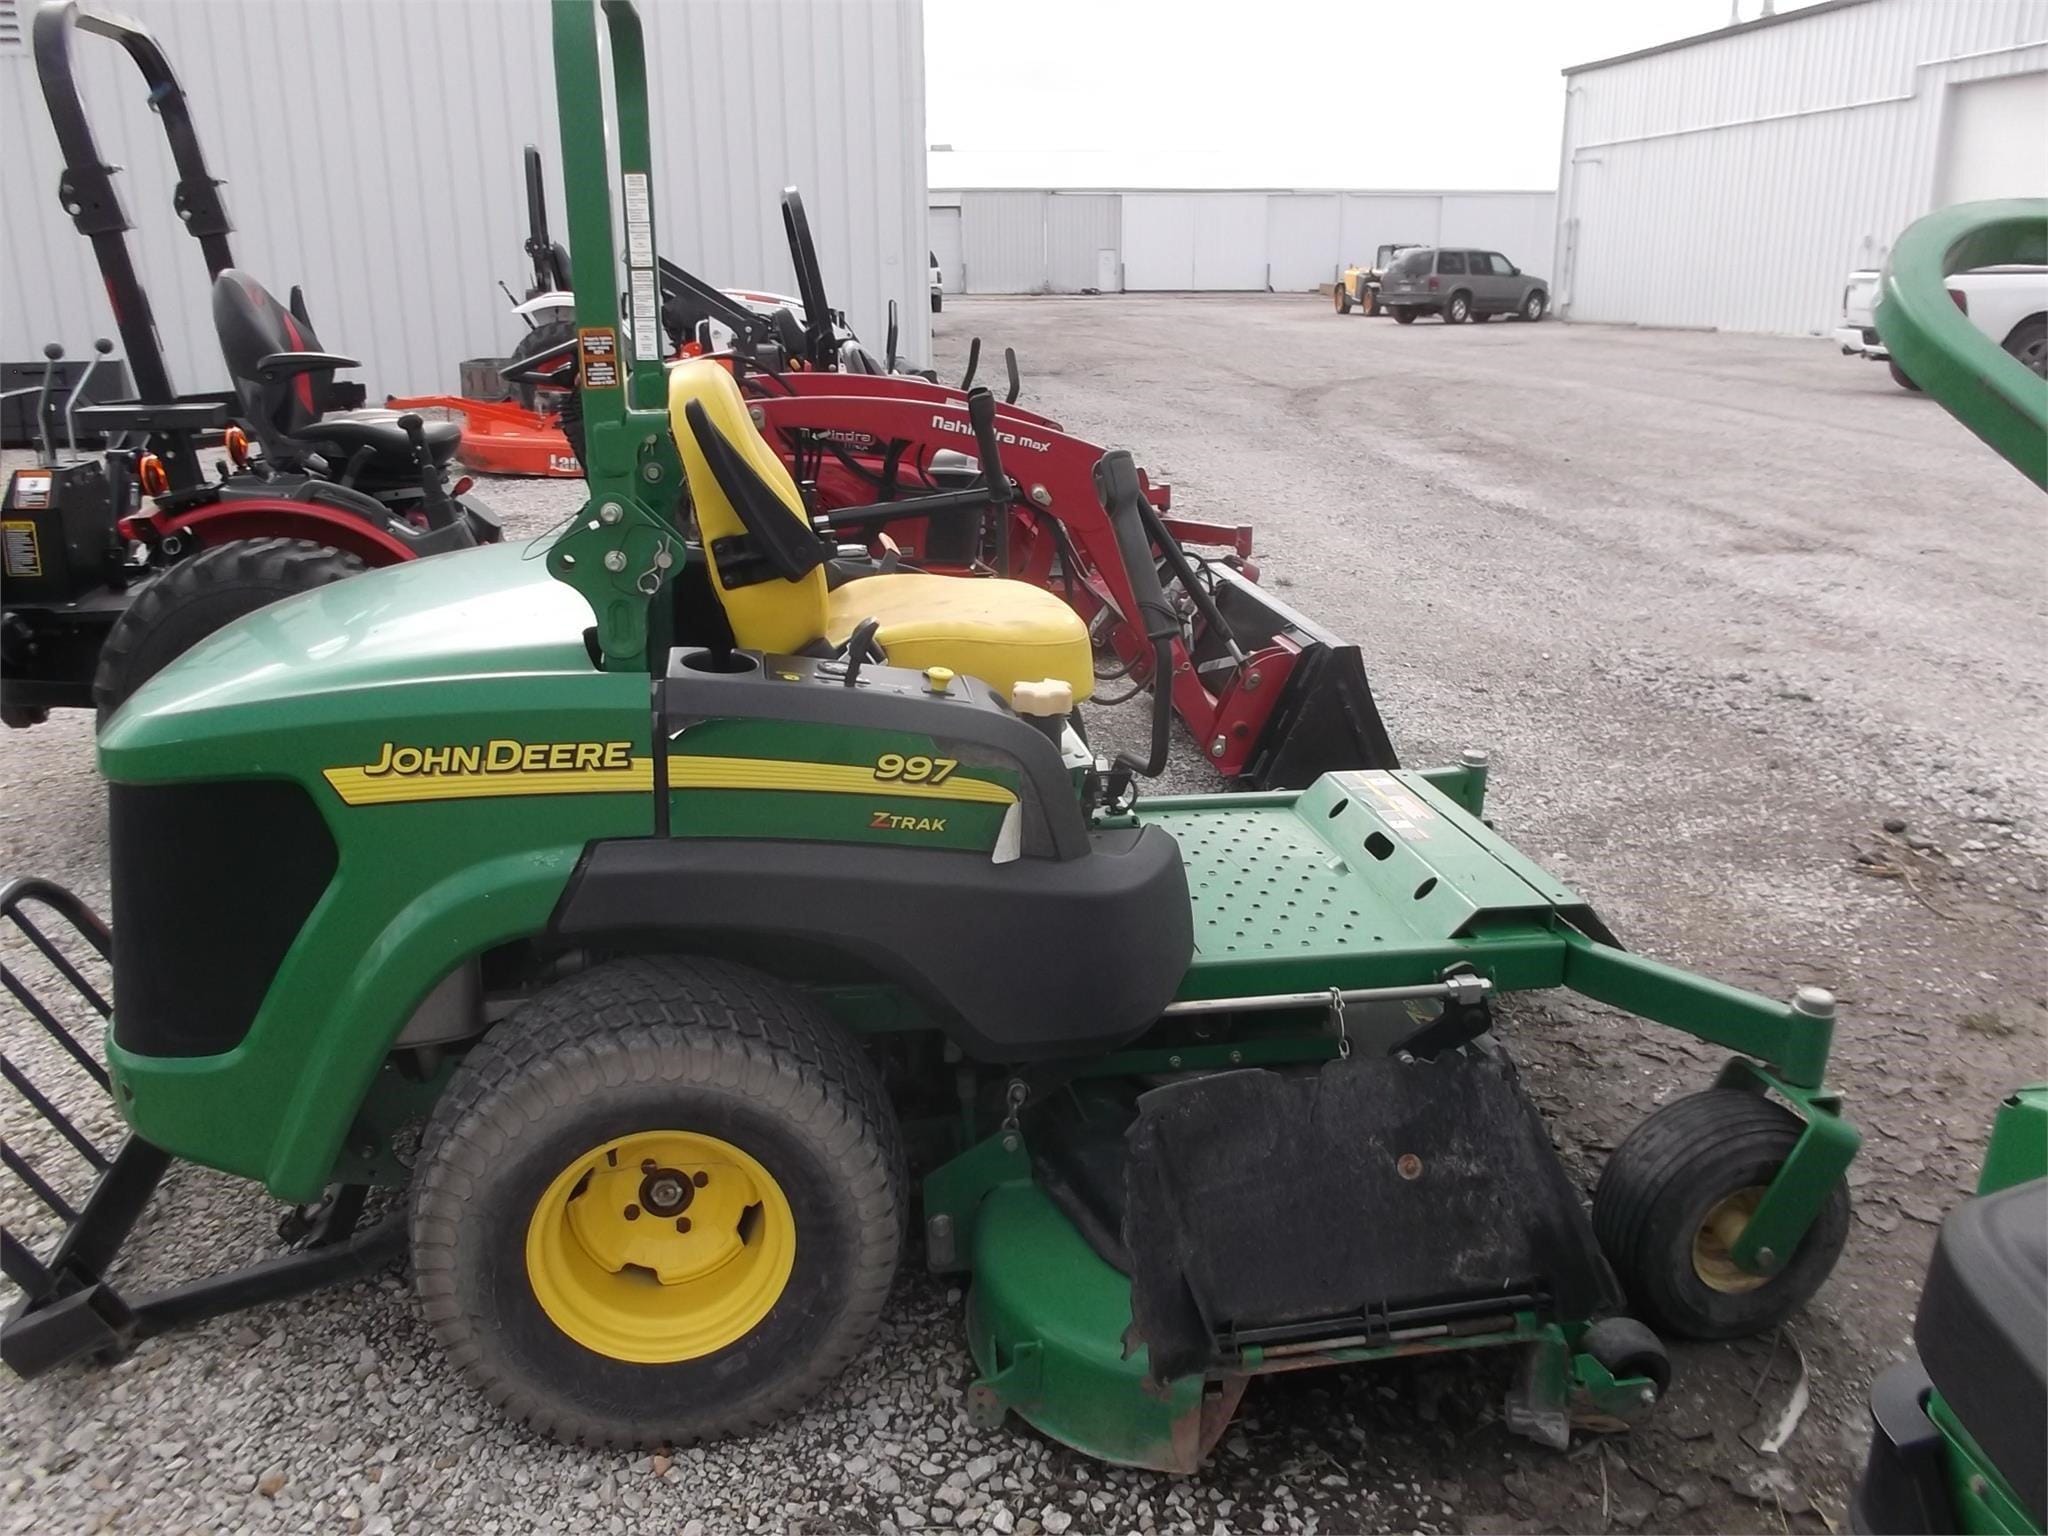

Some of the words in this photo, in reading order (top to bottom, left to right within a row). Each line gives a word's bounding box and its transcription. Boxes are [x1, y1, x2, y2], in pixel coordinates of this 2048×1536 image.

[364, 742, 481, 774] JOHN
[486, 739, 632, 772] DEERE
[875, 753, 958, 783] 997
[869, 811, 947, 832] ZTRAK
